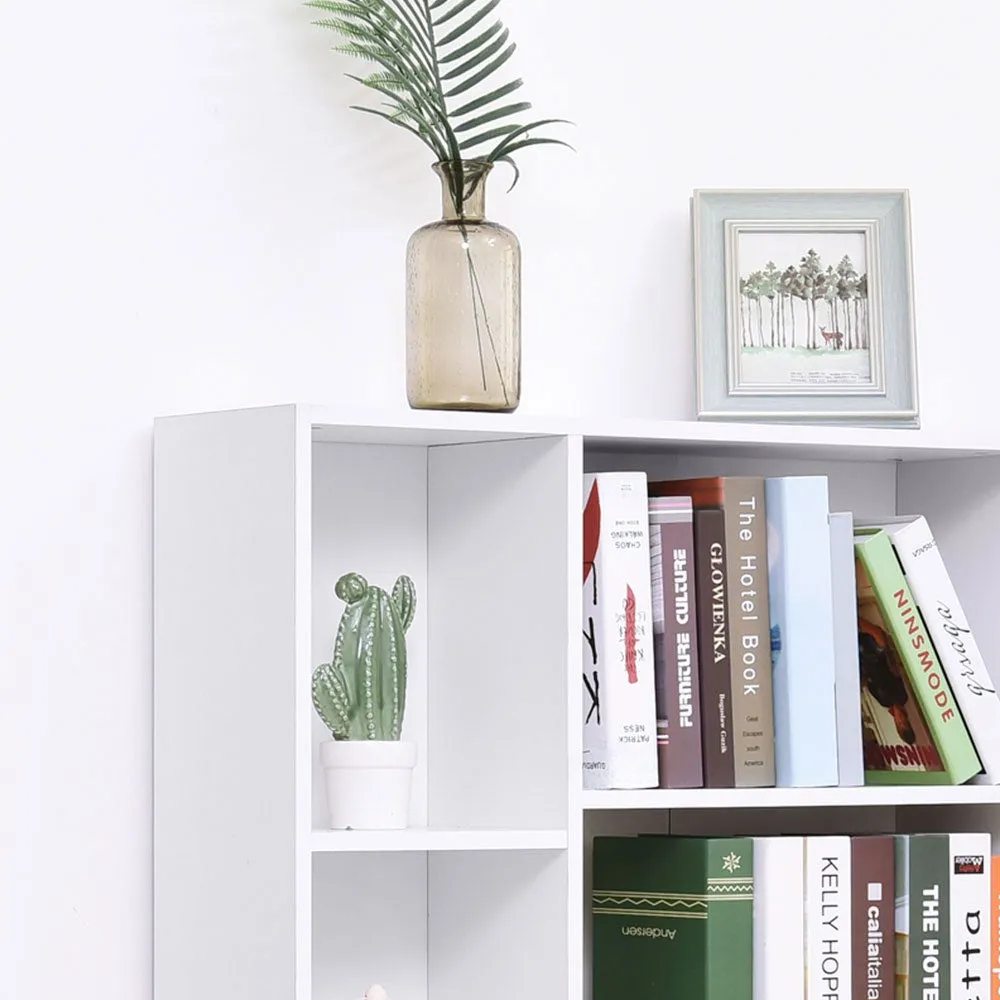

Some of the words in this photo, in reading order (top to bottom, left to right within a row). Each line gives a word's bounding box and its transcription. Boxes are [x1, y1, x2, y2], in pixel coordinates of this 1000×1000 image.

[611, 531, 644, 541] WALKING
[615, 541, 641, 549] CHAOS
[739, 497, 755, 542] The
[673, 549, 689, 624] CULTURE
[740, 556, 757, 620] Hotel
[742, 635, 760, 696] Book
[893, 588, 955, 723] NINSMODE
[618, 734, 650, 744] PATRICK
[821, 857, 839, 931] KELLY
[922, 884, 939, 931] THE
[622, 926, 677, 939] Andersen
[868, 905, 883, 1000] caliaitalia
